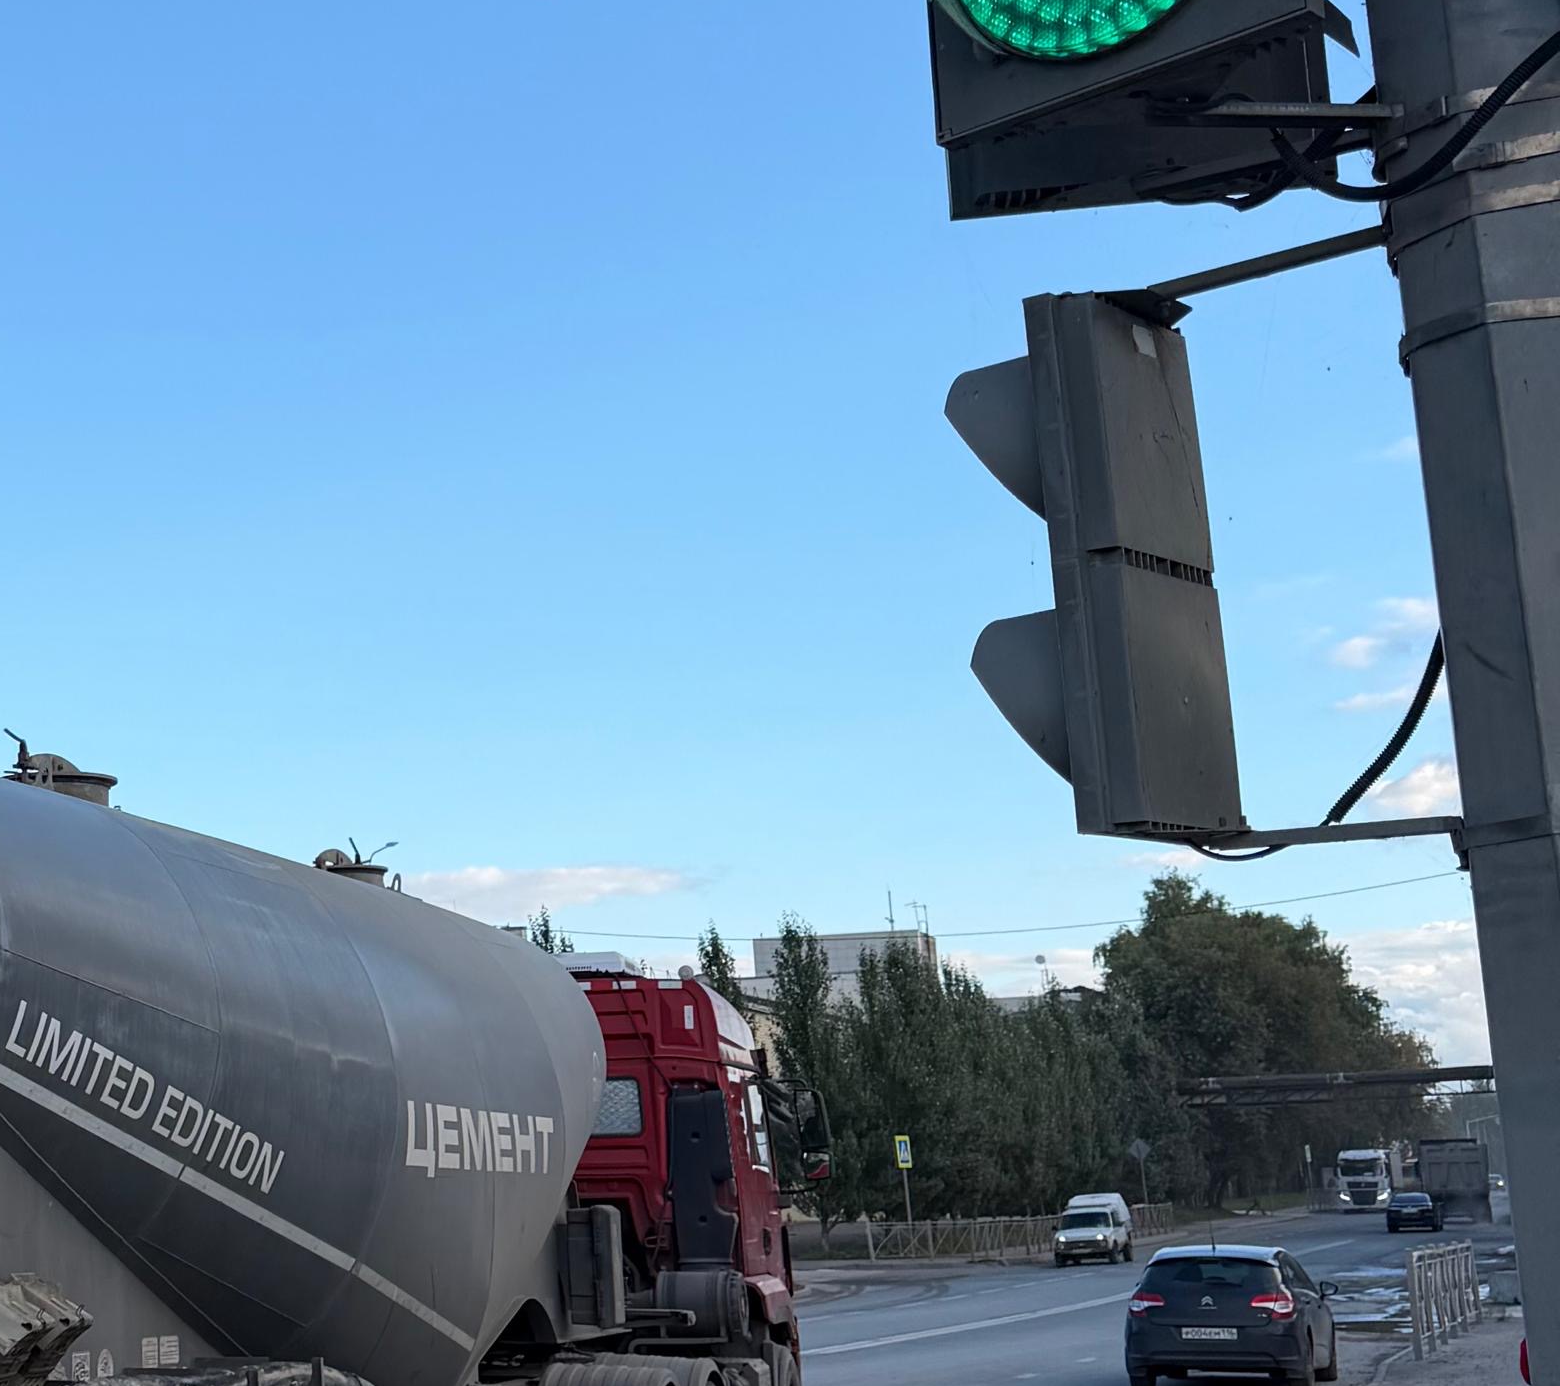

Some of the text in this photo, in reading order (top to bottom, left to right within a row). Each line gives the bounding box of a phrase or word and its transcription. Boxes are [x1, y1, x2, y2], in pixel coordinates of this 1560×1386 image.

[4, 999, 286, 1196] LIMITED EDITION
[404, 1099, 555, 1178] ЦЕМЕНТ
